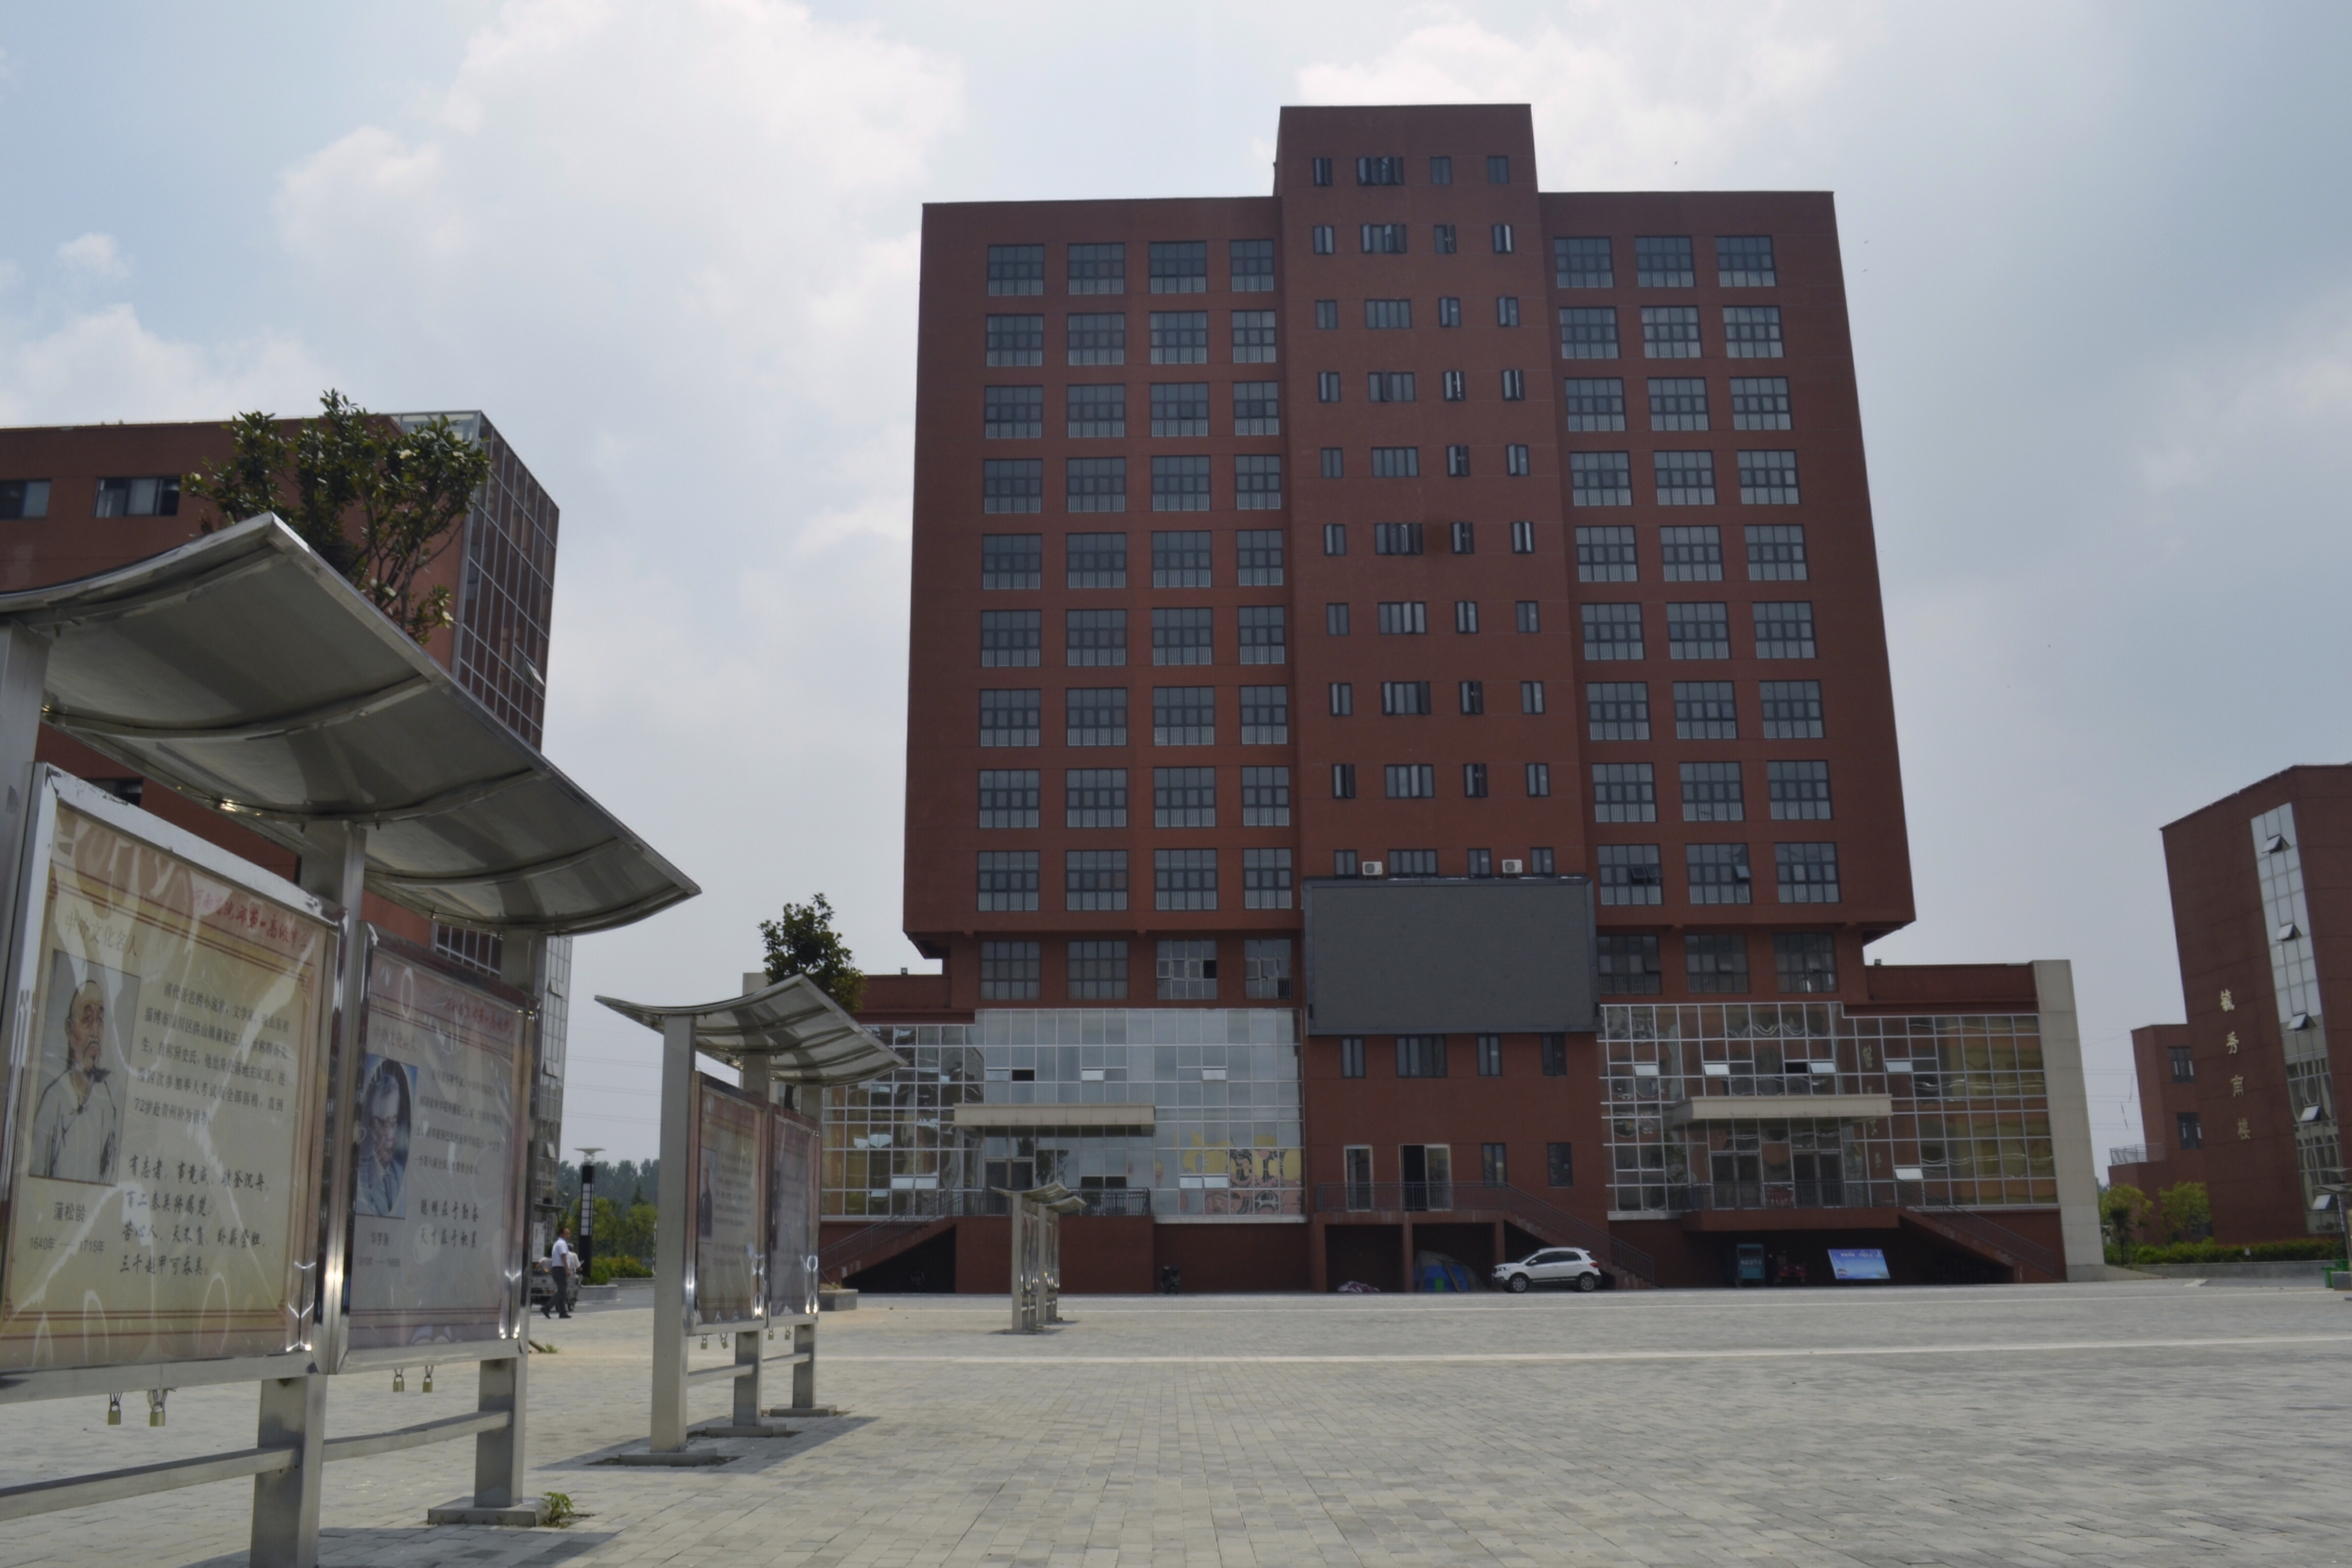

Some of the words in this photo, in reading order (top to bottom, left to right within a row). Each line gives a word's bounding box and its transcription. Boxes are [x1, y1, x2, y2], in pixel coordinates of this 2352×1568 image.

[64, 909, 138, 958] 中外文化名人
[2220, 989, 2250, 1140] 毓秀南楼
[53, 1200, 87, 1223] 蒲松龄
[420, 1197, 479, 1222] 聪明在于勤奋
[29, 1236, 56, 1251] 1640年
[79, 1239, 105, 1254] 1715年
[370, 1231, 389, 1246] 华罗庚
[420, 1227, 477, 1248] 天才在于积累
